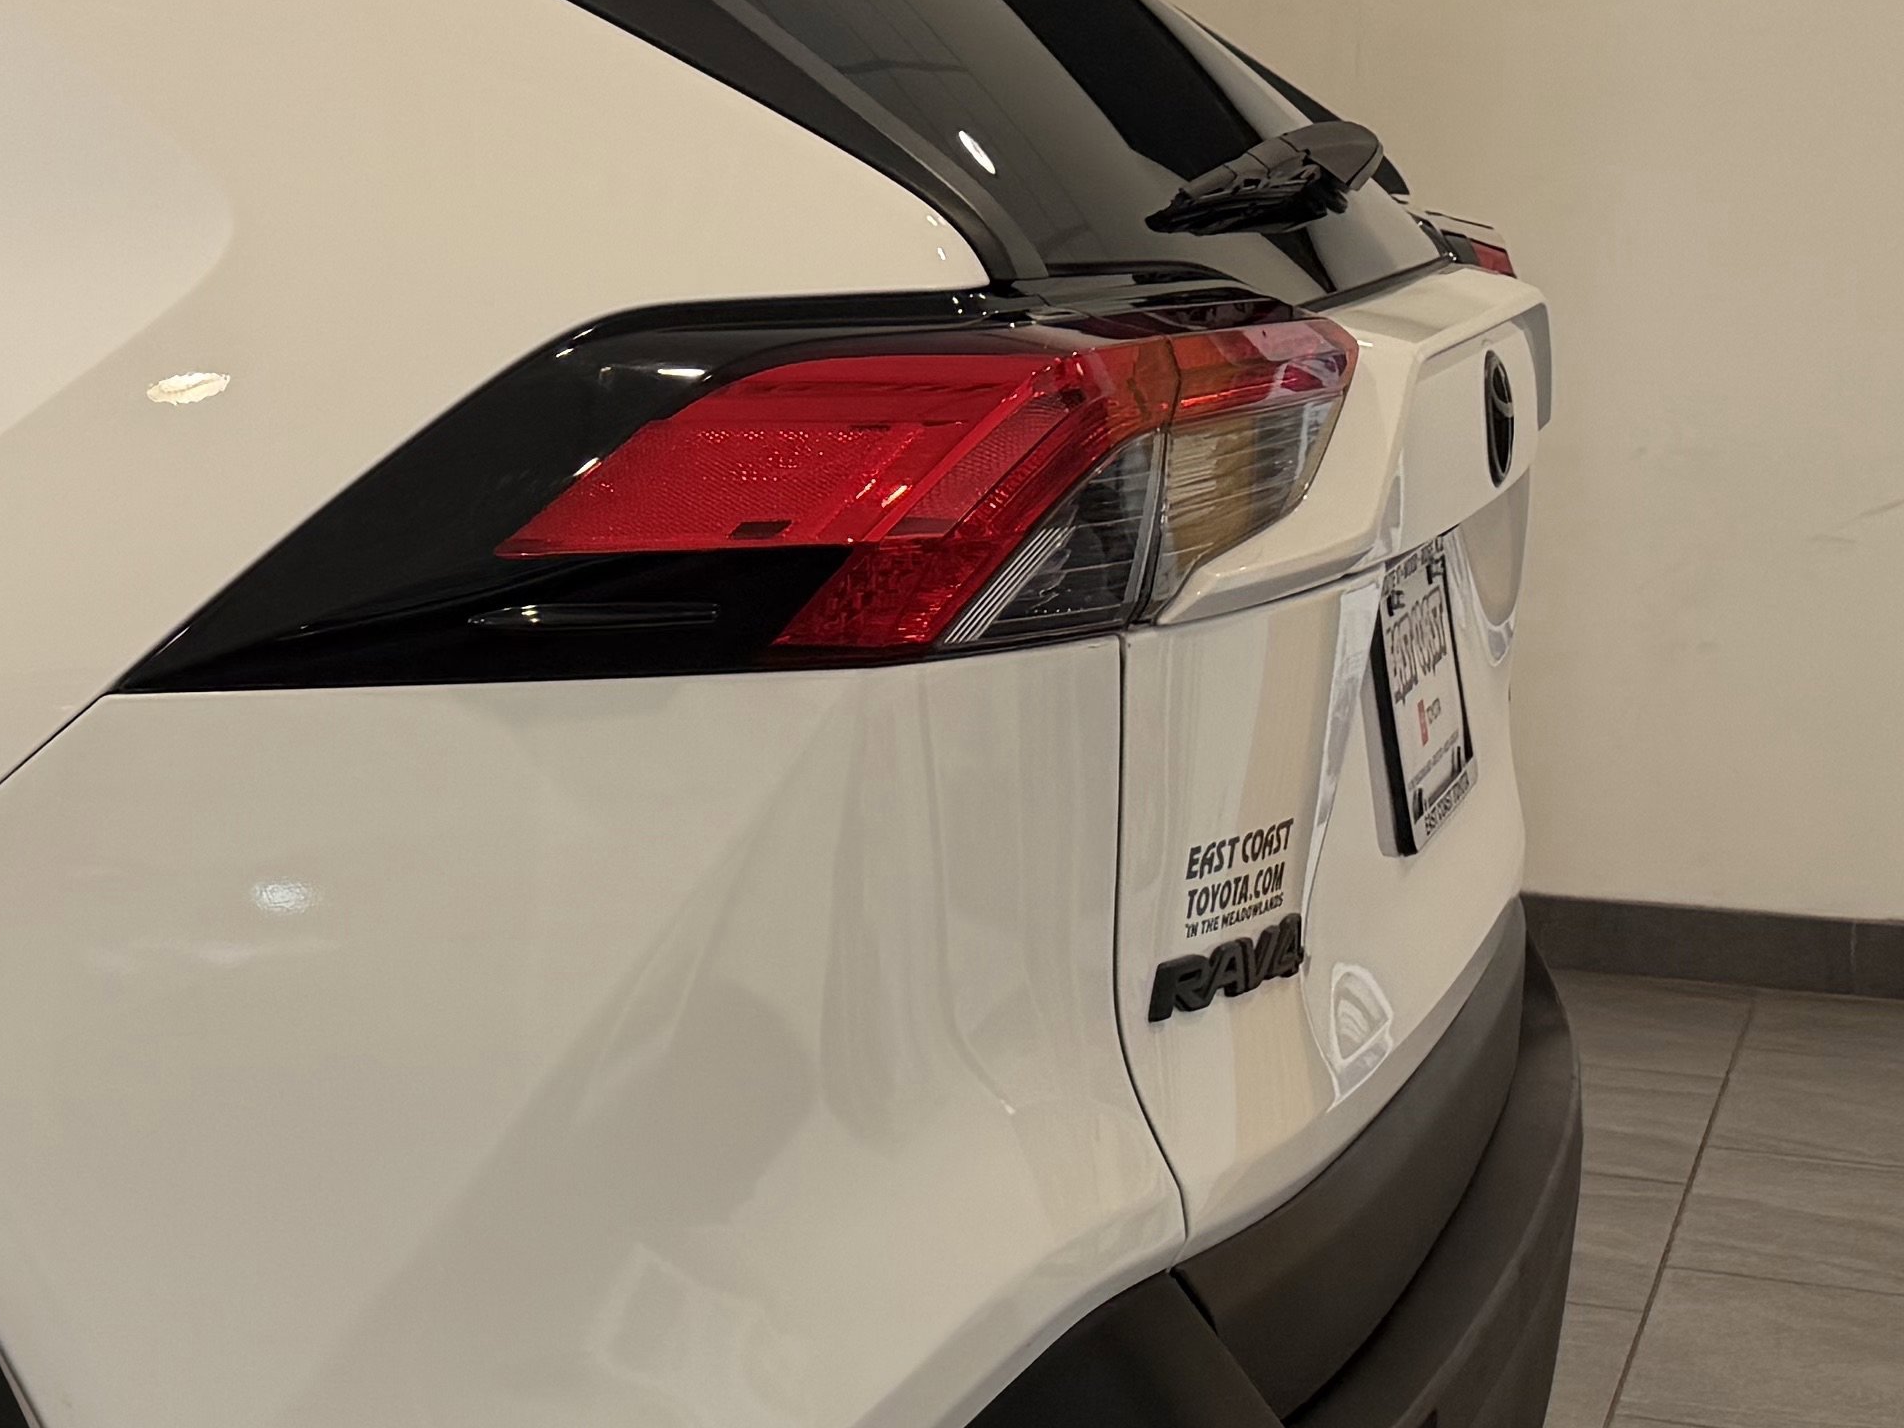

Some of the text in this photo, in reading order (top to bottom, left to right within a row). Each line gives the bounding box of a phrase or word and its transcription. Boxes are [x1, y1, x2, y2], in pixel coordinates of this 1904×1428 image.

[1185, 817, 1294, 880] EAST COAST
[1187, 861, 1285, 919] TOYOTA.COM
[1201, 915, 1220, 935] THE
[1148, 913, 1304, 1022] RAV4
